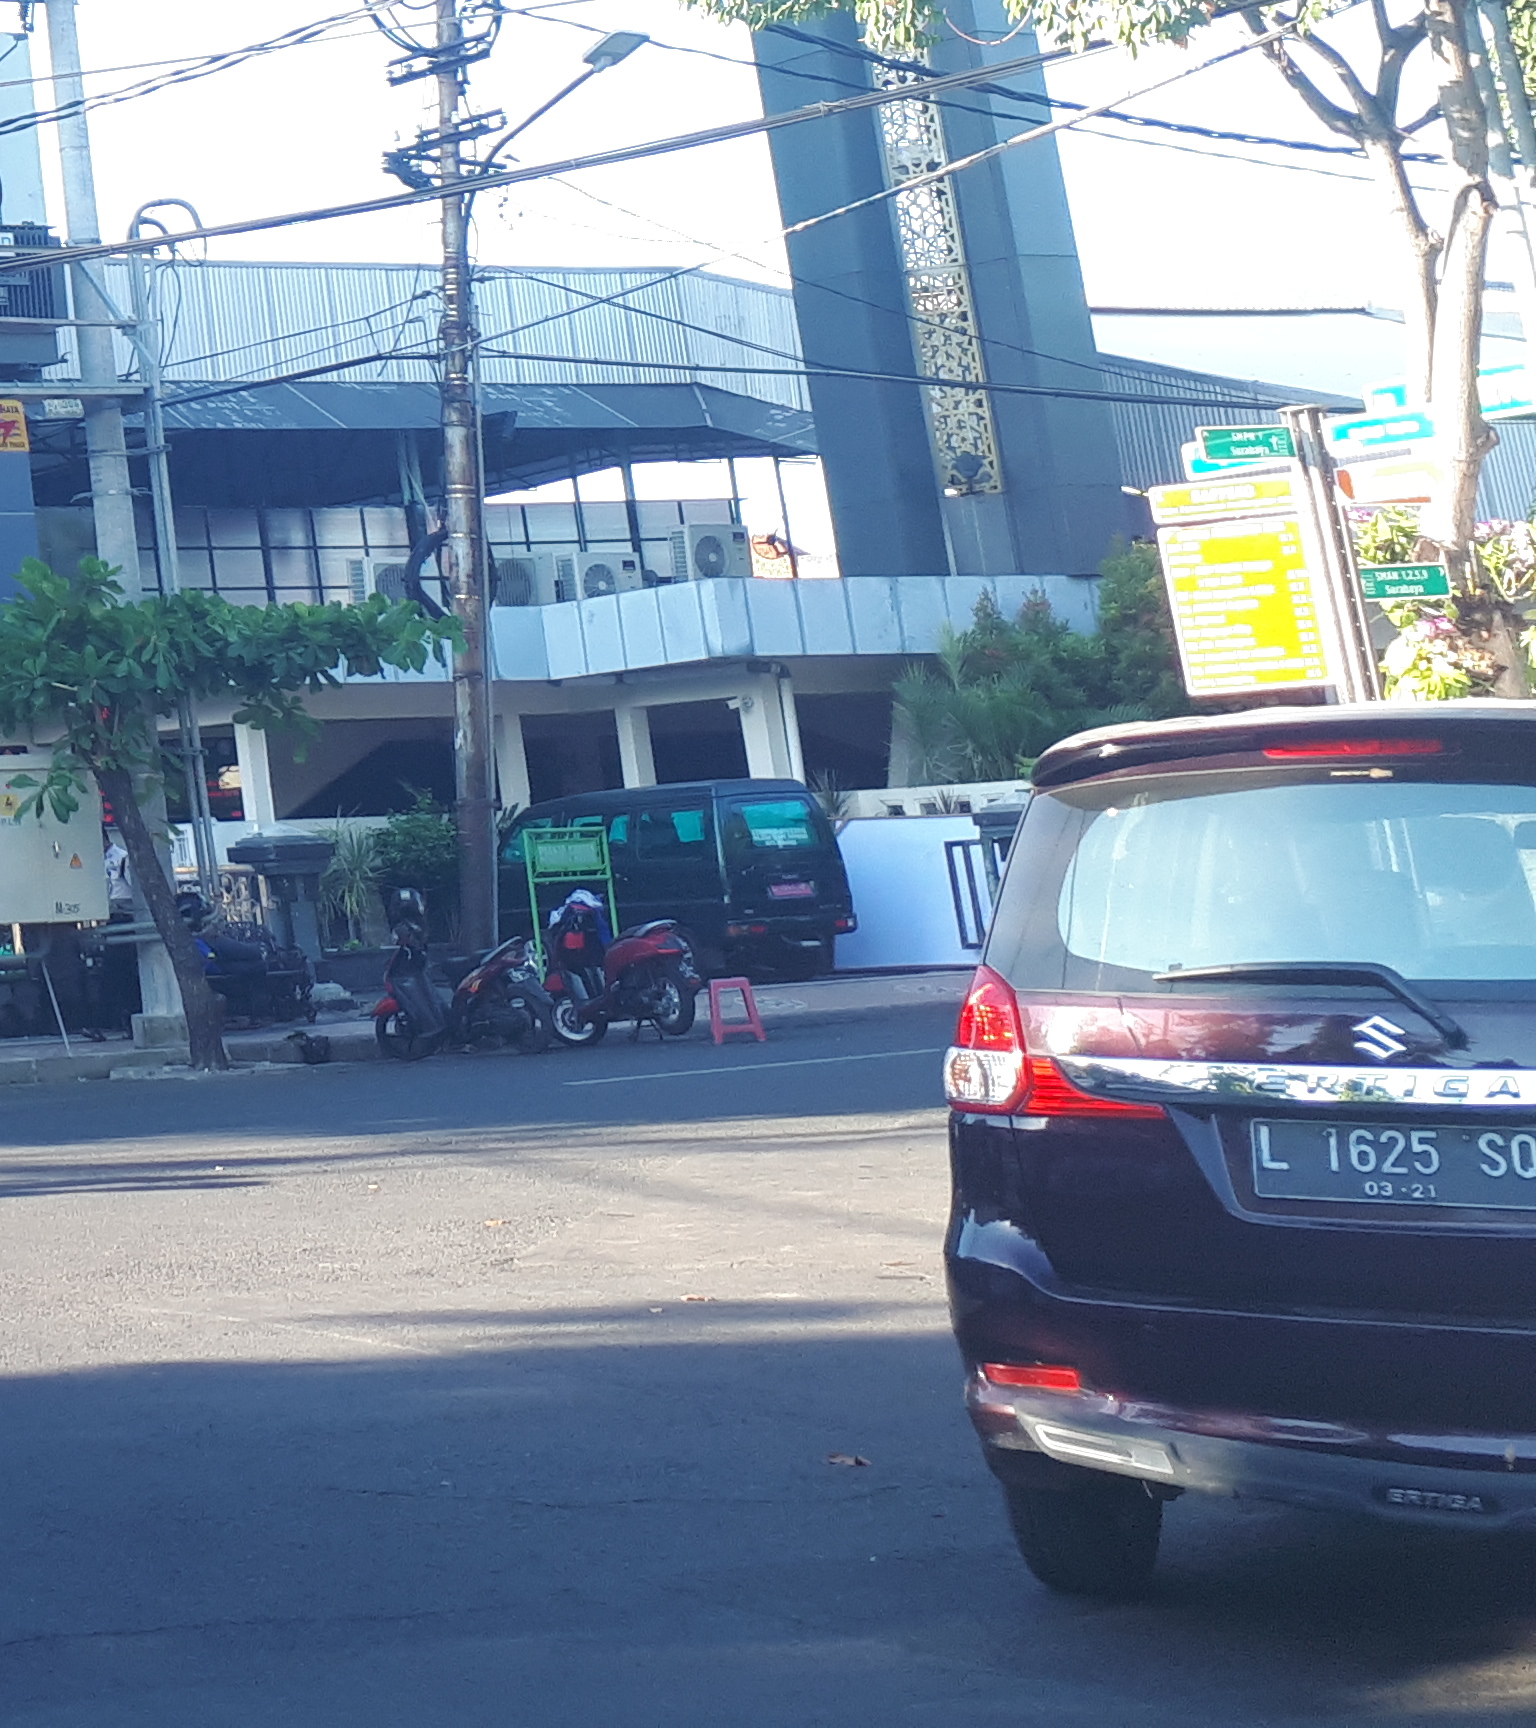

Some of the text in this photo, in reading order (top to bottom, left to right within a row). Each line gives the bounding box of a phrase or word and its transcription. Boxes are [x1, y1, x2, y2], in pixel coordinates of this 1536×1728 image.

[1252, 1068, 1522, 1100] ERTIGA
[1259, 1124, 1536, 1179] L 1625 SQ
